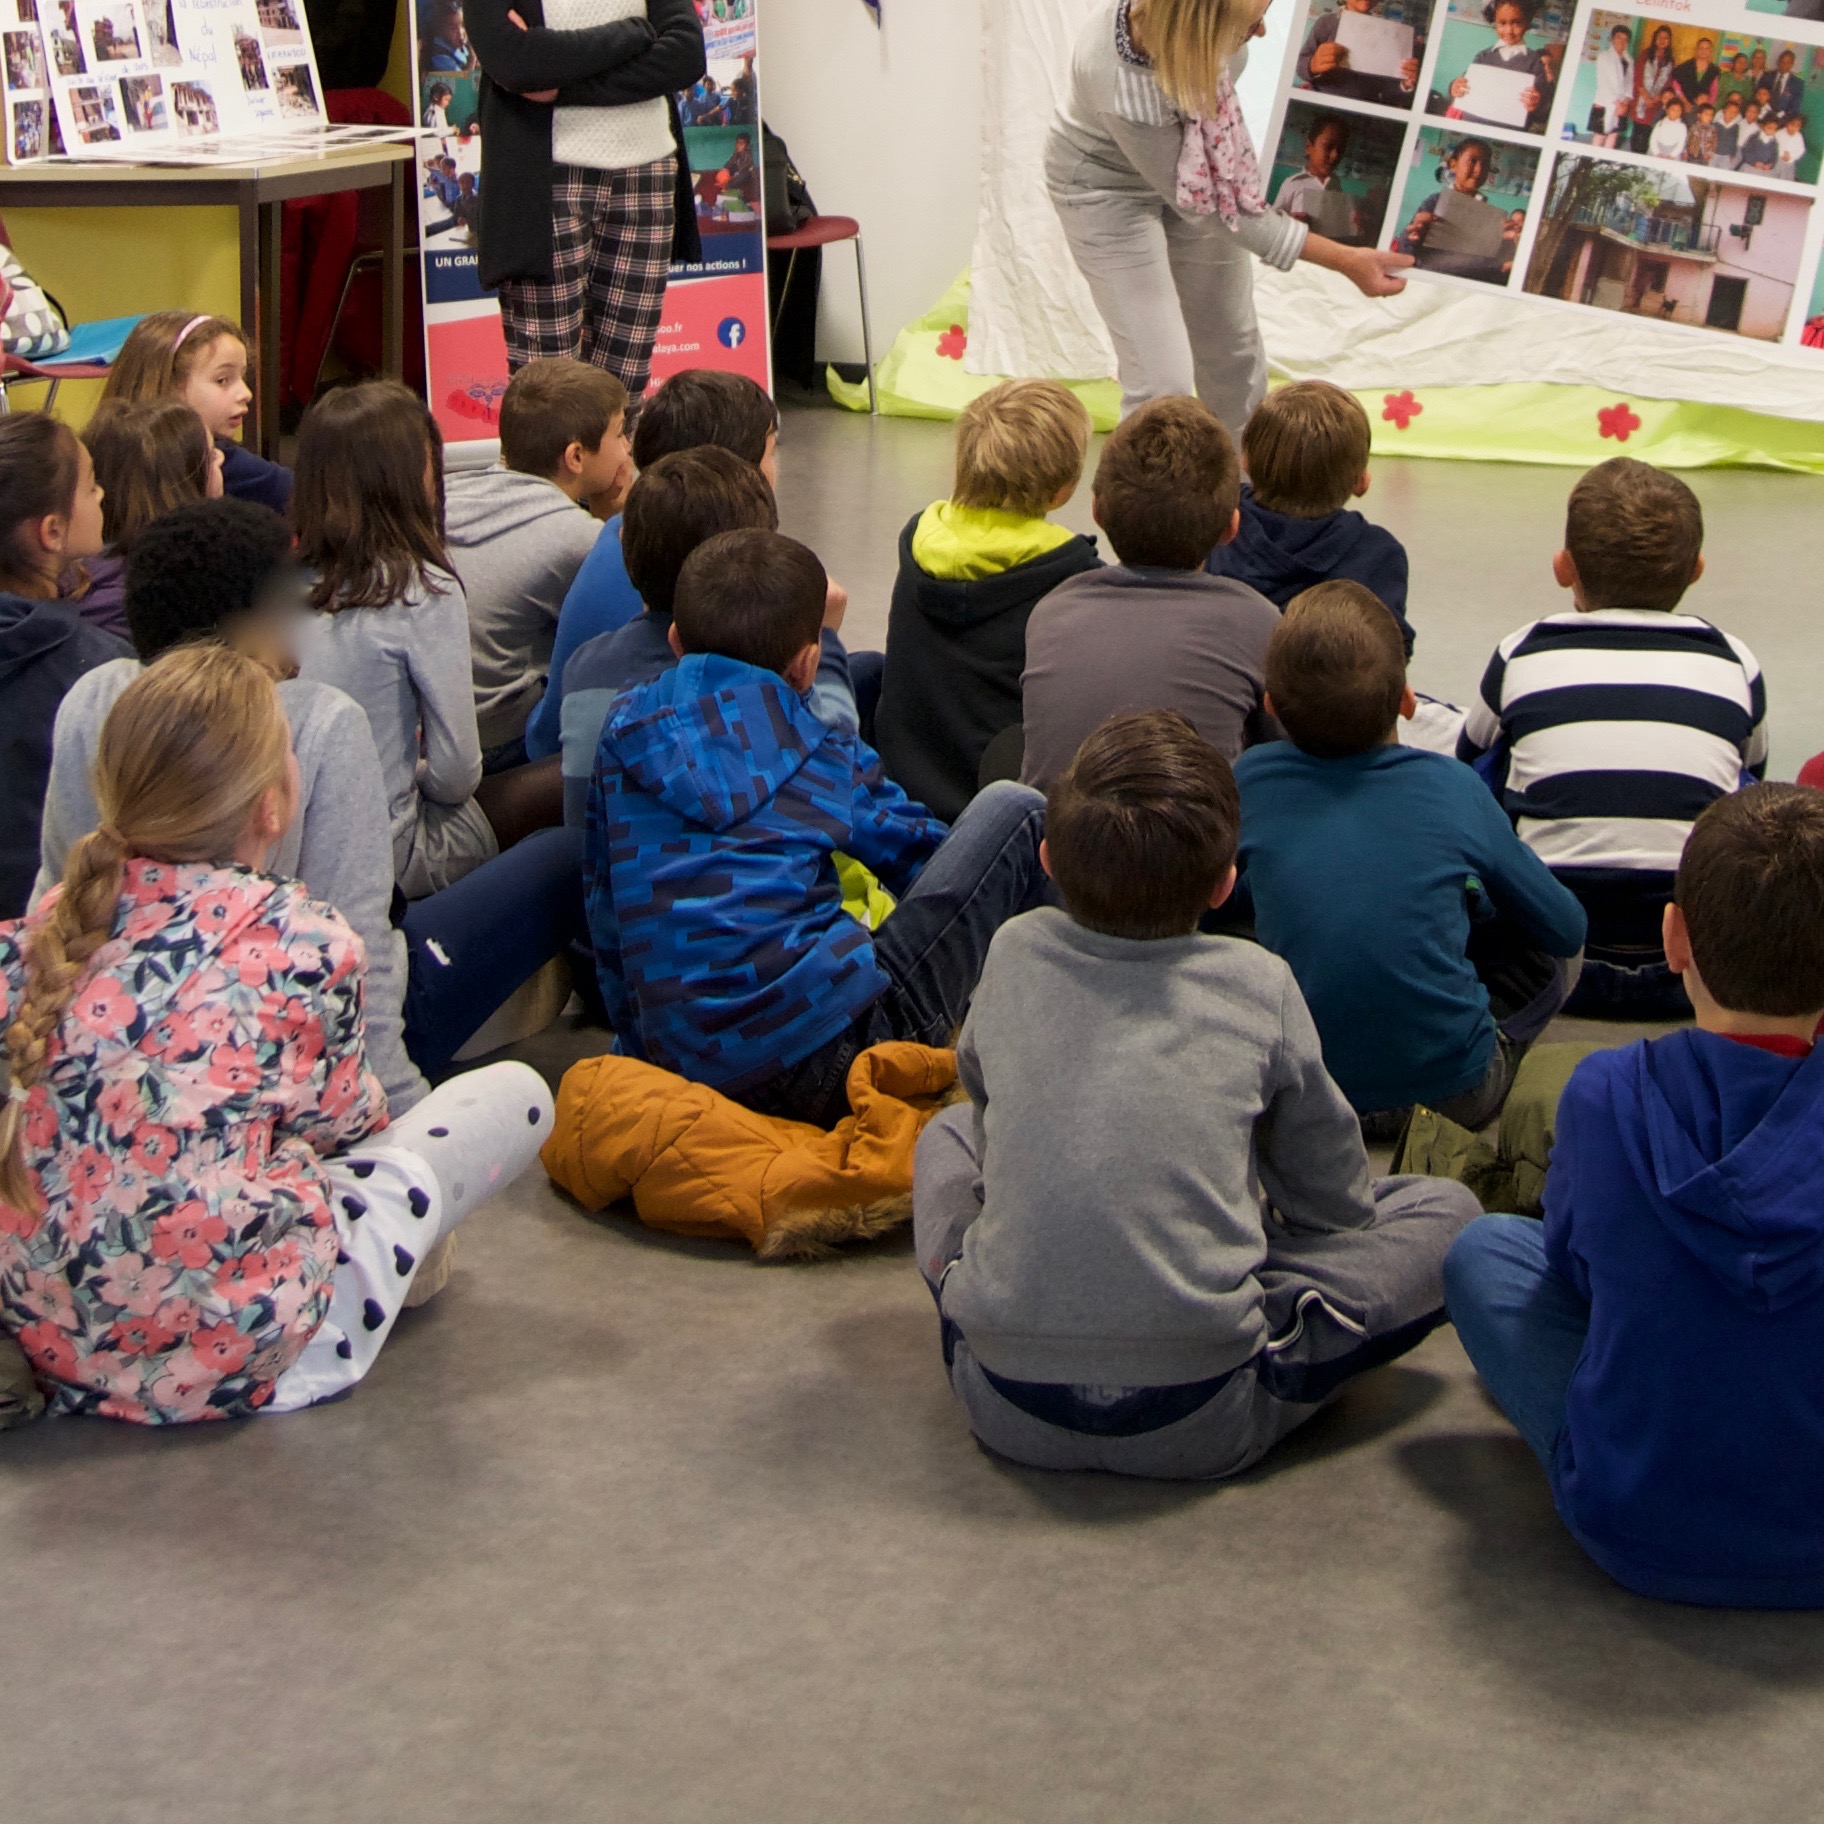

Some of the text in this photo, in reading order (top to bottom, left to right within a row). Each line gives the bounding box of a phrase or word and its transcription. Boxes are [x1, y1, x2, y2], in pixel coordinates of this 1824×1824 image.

[435, 256, 453, 268] UN
[686, 262, 704, 272] nos
[705, 260, 740, 272] actions
[657, 322, 683, 334] oo.fr
[652, 342, 700, 355] alaya.com
